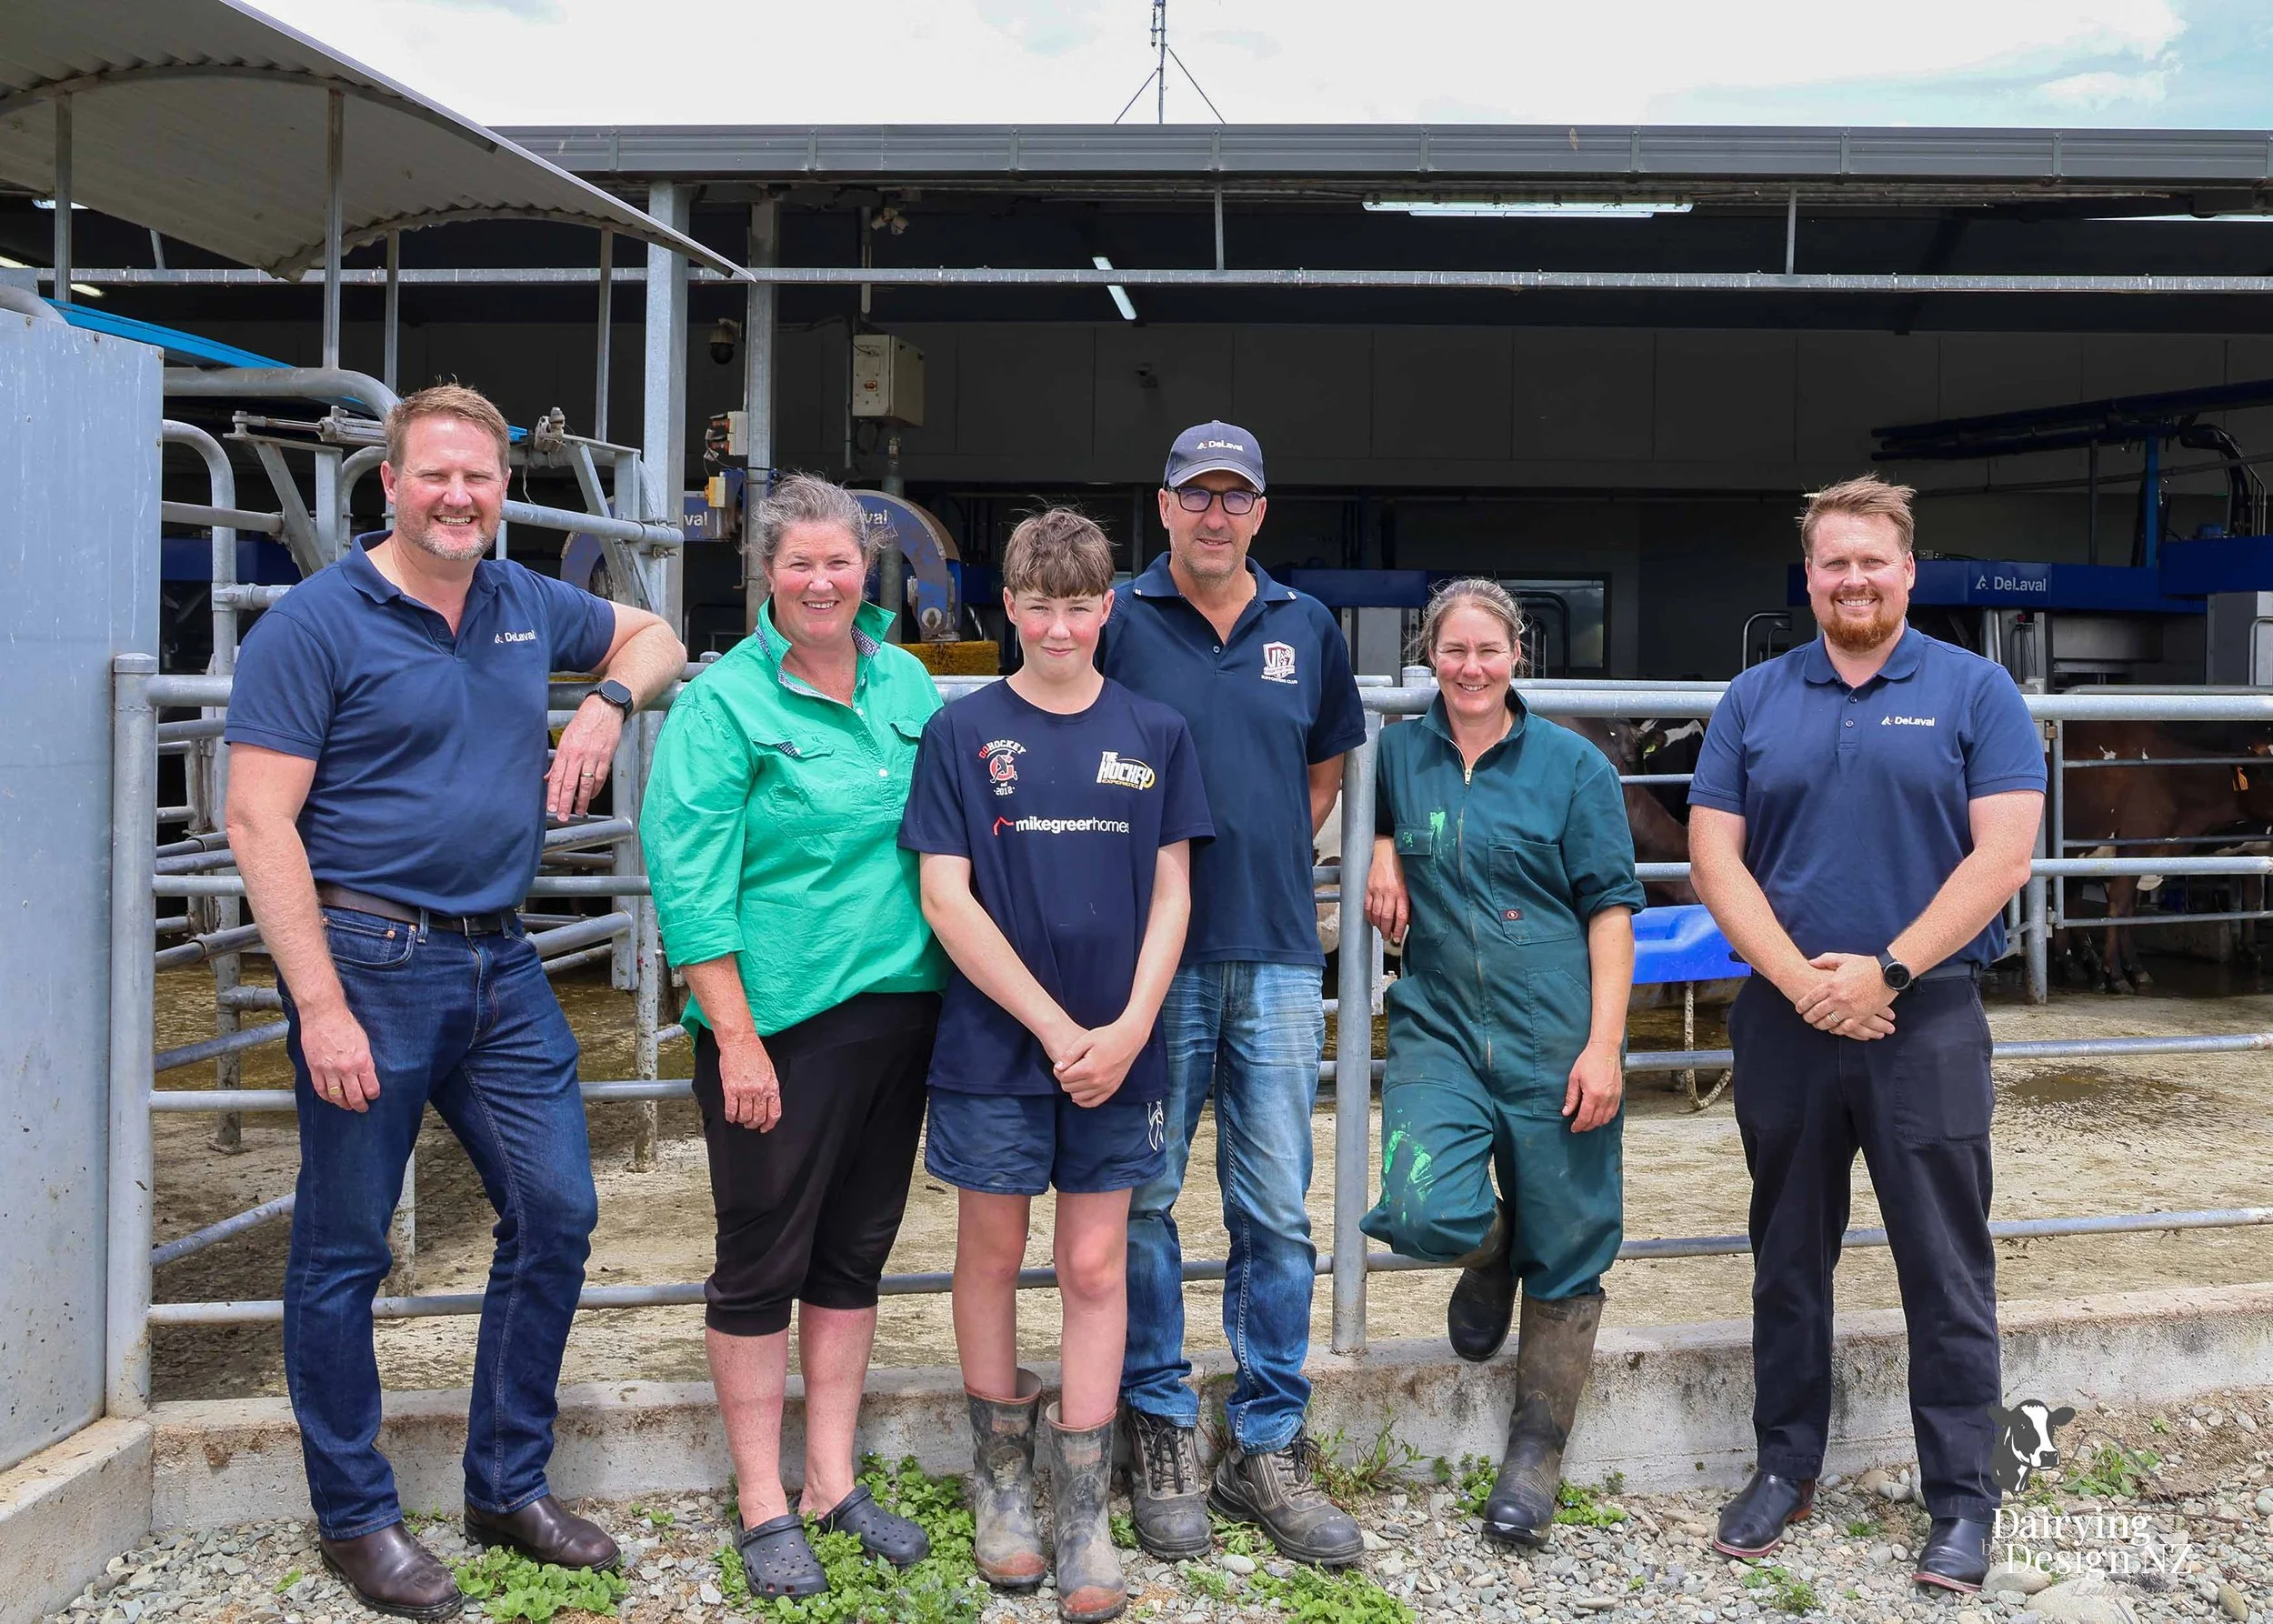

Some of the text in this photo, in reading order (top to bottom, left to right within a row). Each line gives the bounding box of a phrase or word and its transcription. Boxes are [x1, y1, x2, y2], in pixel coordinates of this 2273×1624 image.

[1208, 439, 1244, 452] DeLaval
[1994, 576, 2047, 592] DeLaval
[504, 629, 536, 642] DeLaval
[1894, 716, 1936, 727] DeLaval
[1101, 750, 1119, 763] THE
[1096, 761, 1153, 791] HOCKEY
